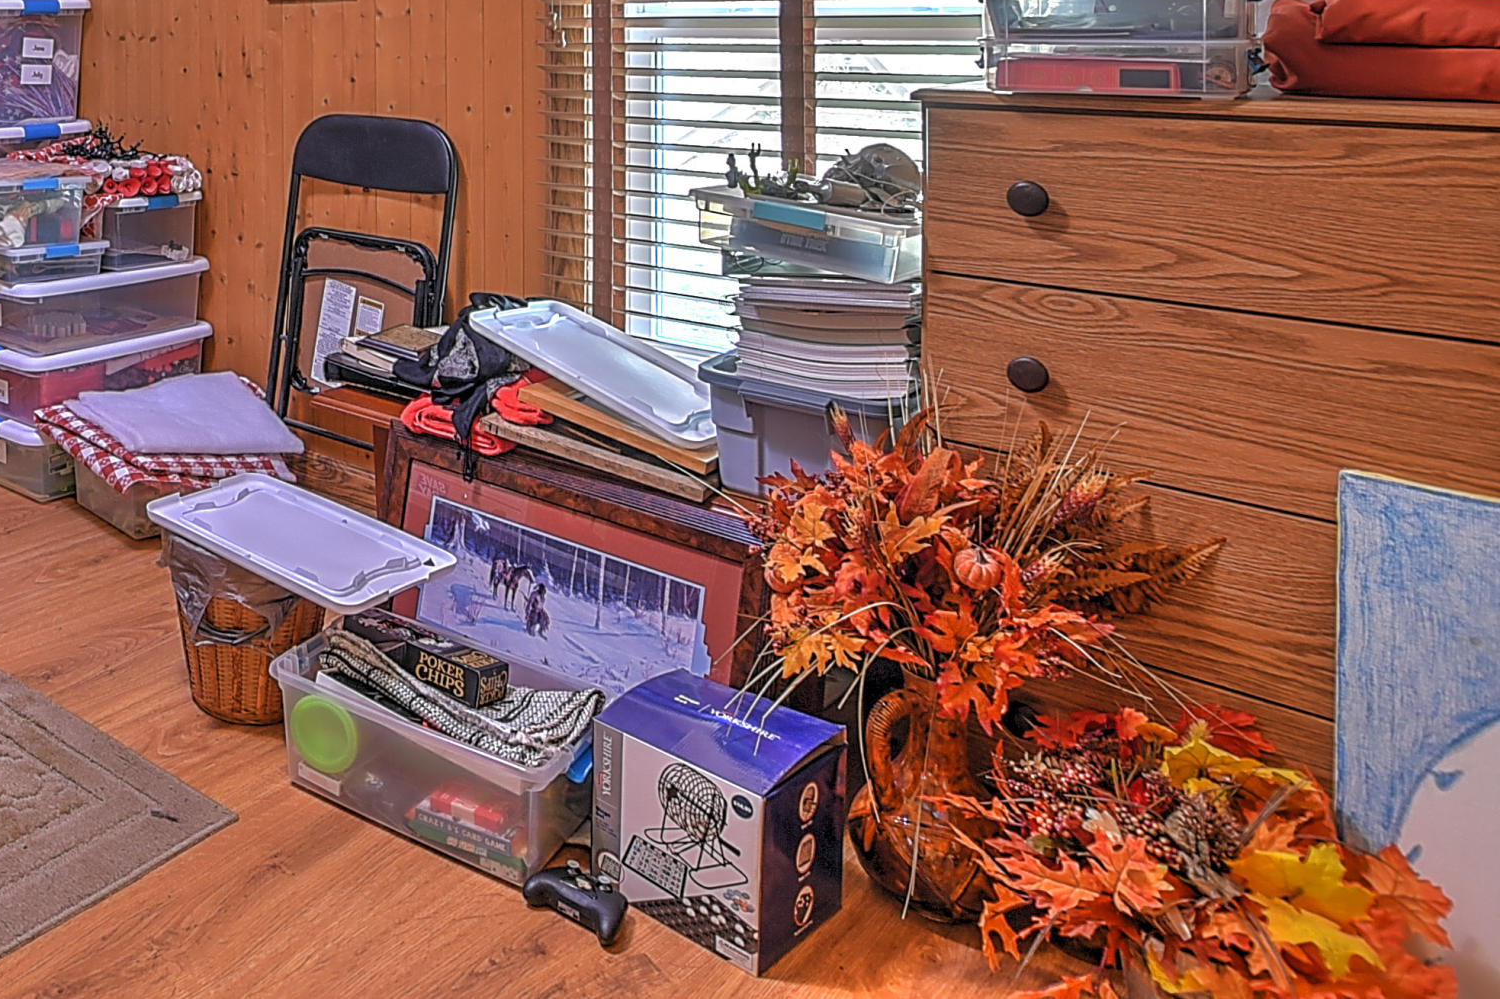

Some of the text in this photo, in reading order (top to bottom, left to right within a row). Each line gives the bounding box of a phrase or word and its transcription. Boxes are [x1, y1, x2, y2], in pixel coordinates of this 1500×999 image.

[31, 44, 45, 52] June
[31, 70, 43, 80] July
[415, 663, 465, 698] CHIPS
[419, 651, 464, 682] POKER
[710, 708, 781, 741] YORKSHIRE
[602, 732, 613, 796] YORKSHIRE
[417, 812, 444, 829] CRAZY
[461, 827, 482, 843] CARD
[484, 838, 507, 850] GAME
